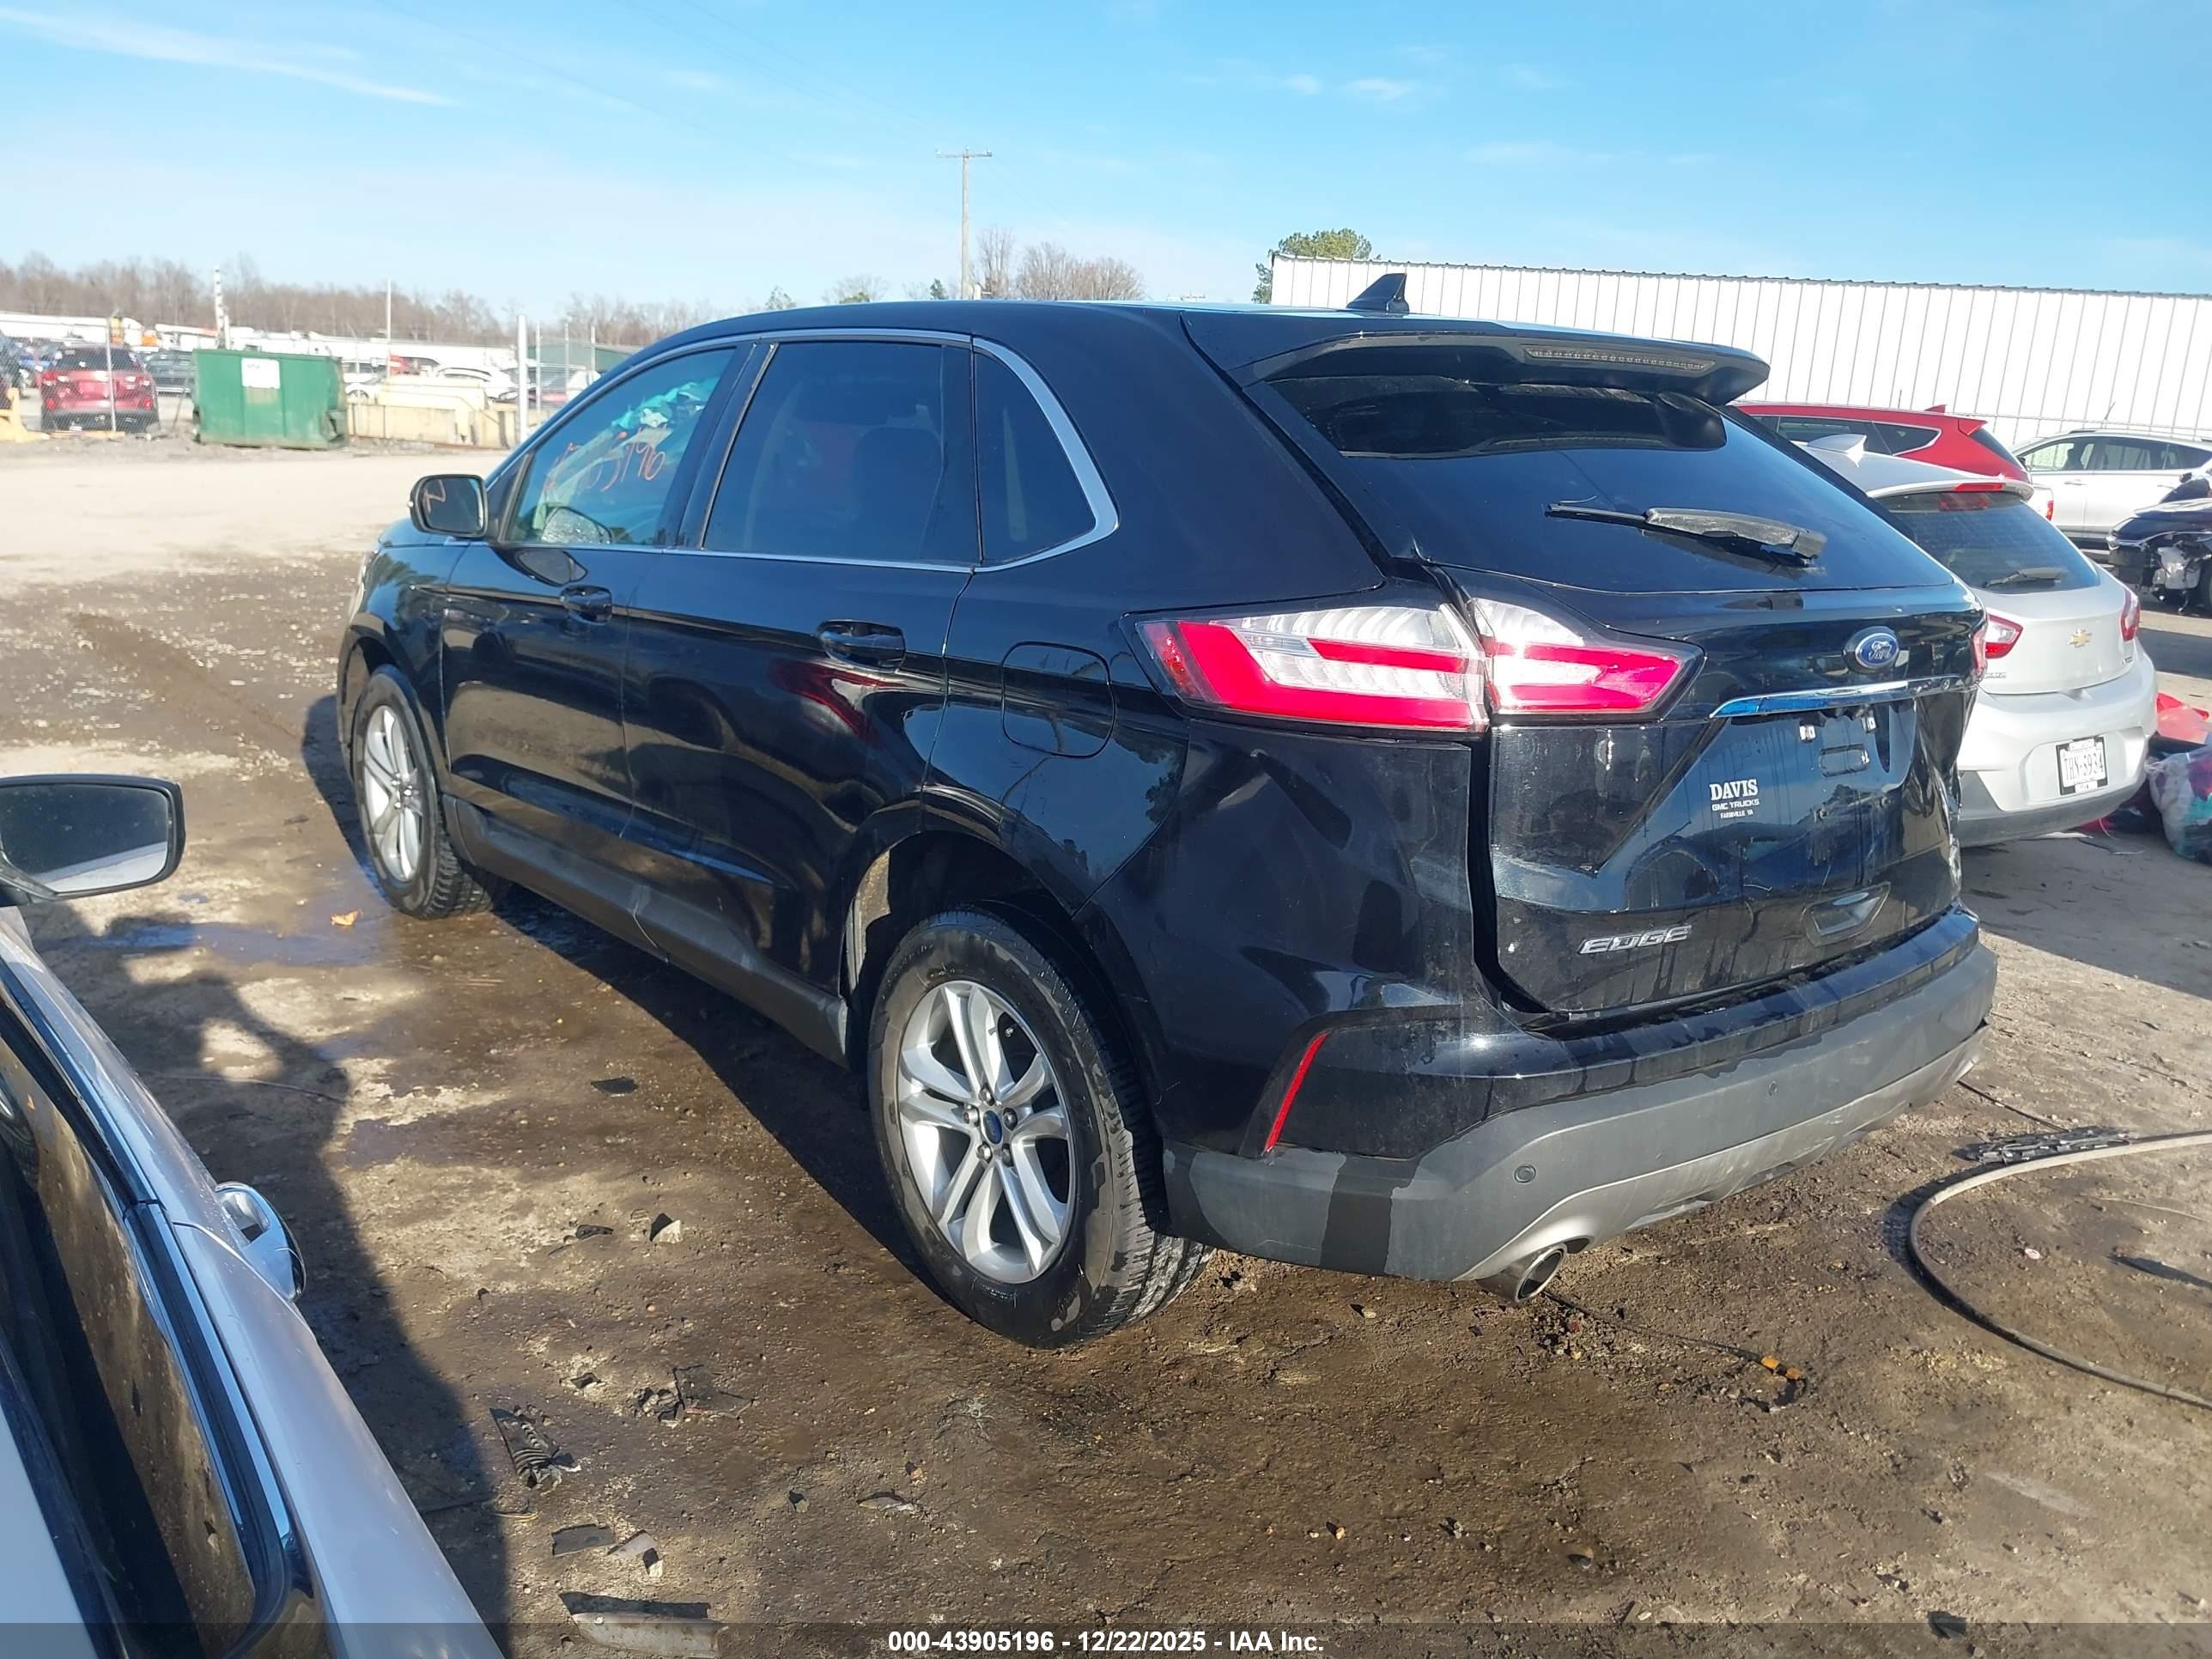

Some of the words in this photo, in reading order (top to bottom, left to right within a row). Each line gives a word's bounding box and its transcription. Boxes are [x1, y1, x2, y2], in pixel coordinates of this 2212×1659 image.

[1868, 641, 1893, 661] Ford
[1709, 778, 1759, 800] DAVIS
[1711, 802, 1729, 811] GMC
[1729, 799, 1760, 809] TRUCKS
[1578, 924, 1692, 955] EDGE
